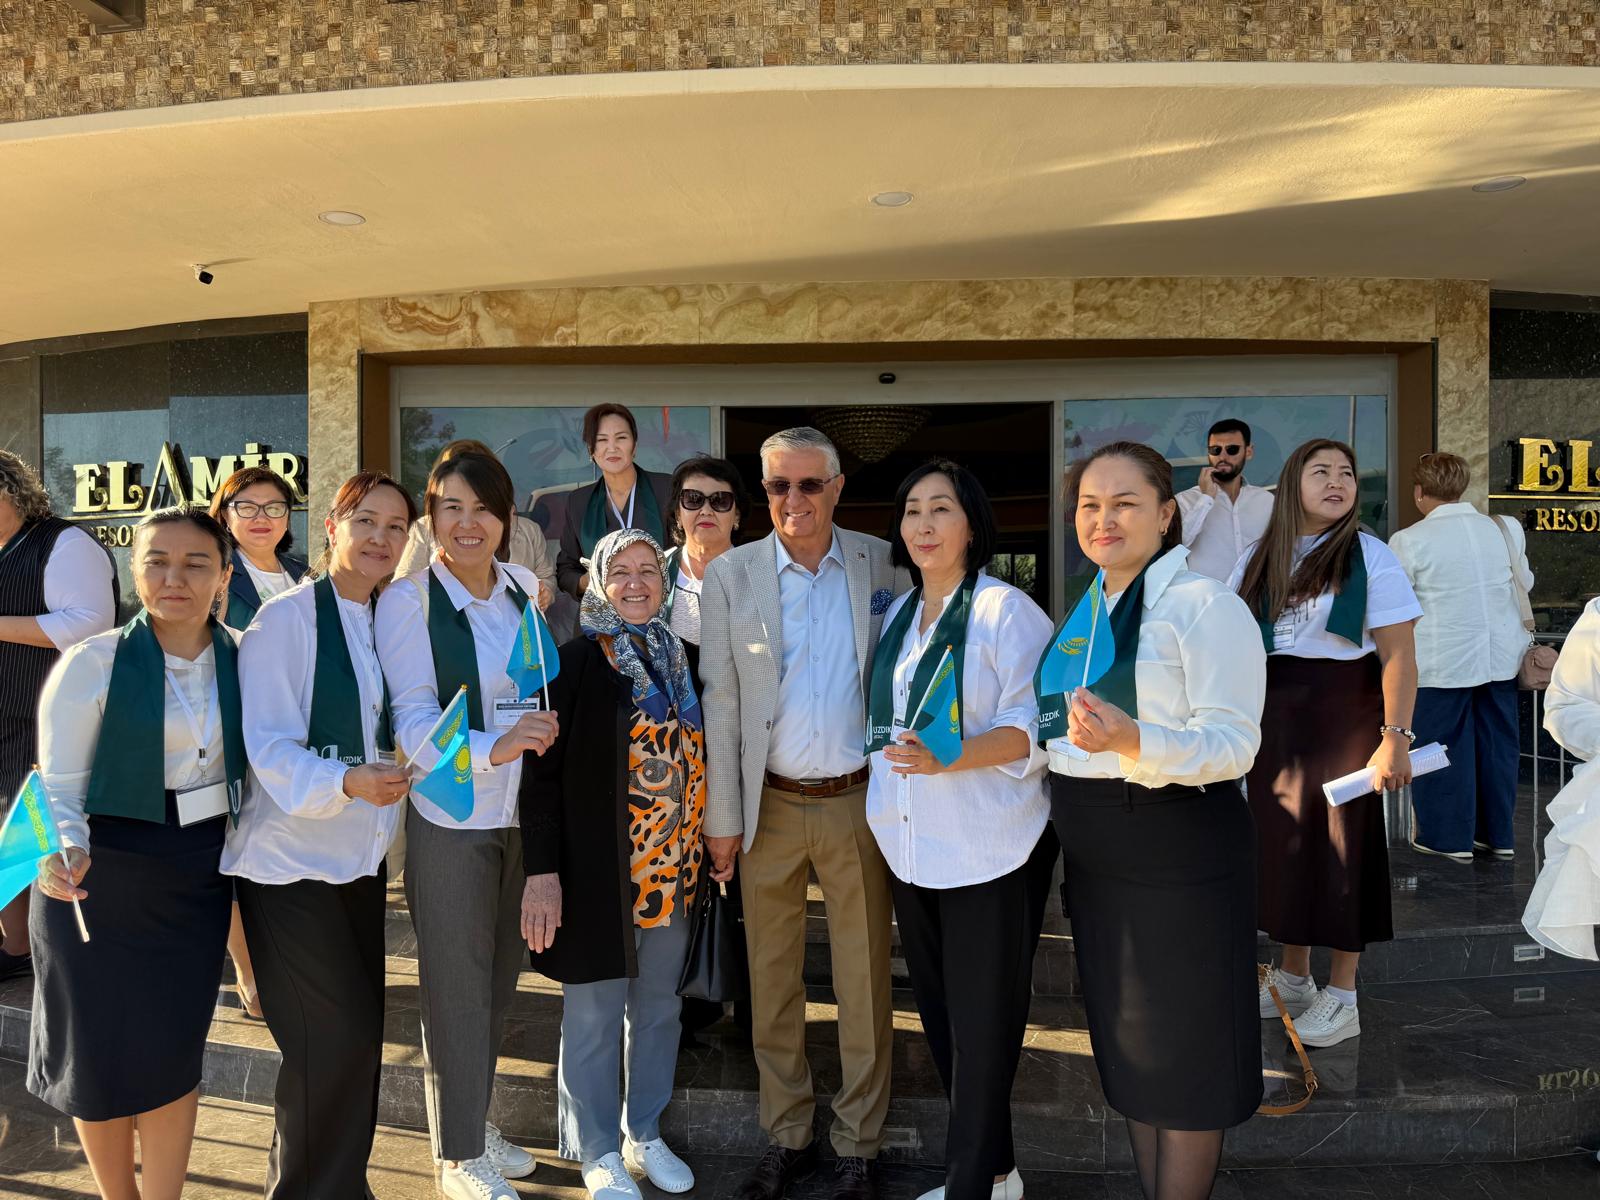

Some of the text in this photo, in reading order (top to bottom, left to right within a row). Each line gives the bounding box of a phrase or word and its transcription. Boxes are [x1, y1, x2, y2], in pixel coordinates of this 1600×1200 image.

[1536, 507, 1600, 532] RESO
[90, 524, 137, 547] ESO
[1039, 709, 1060, 723] UZDIK
